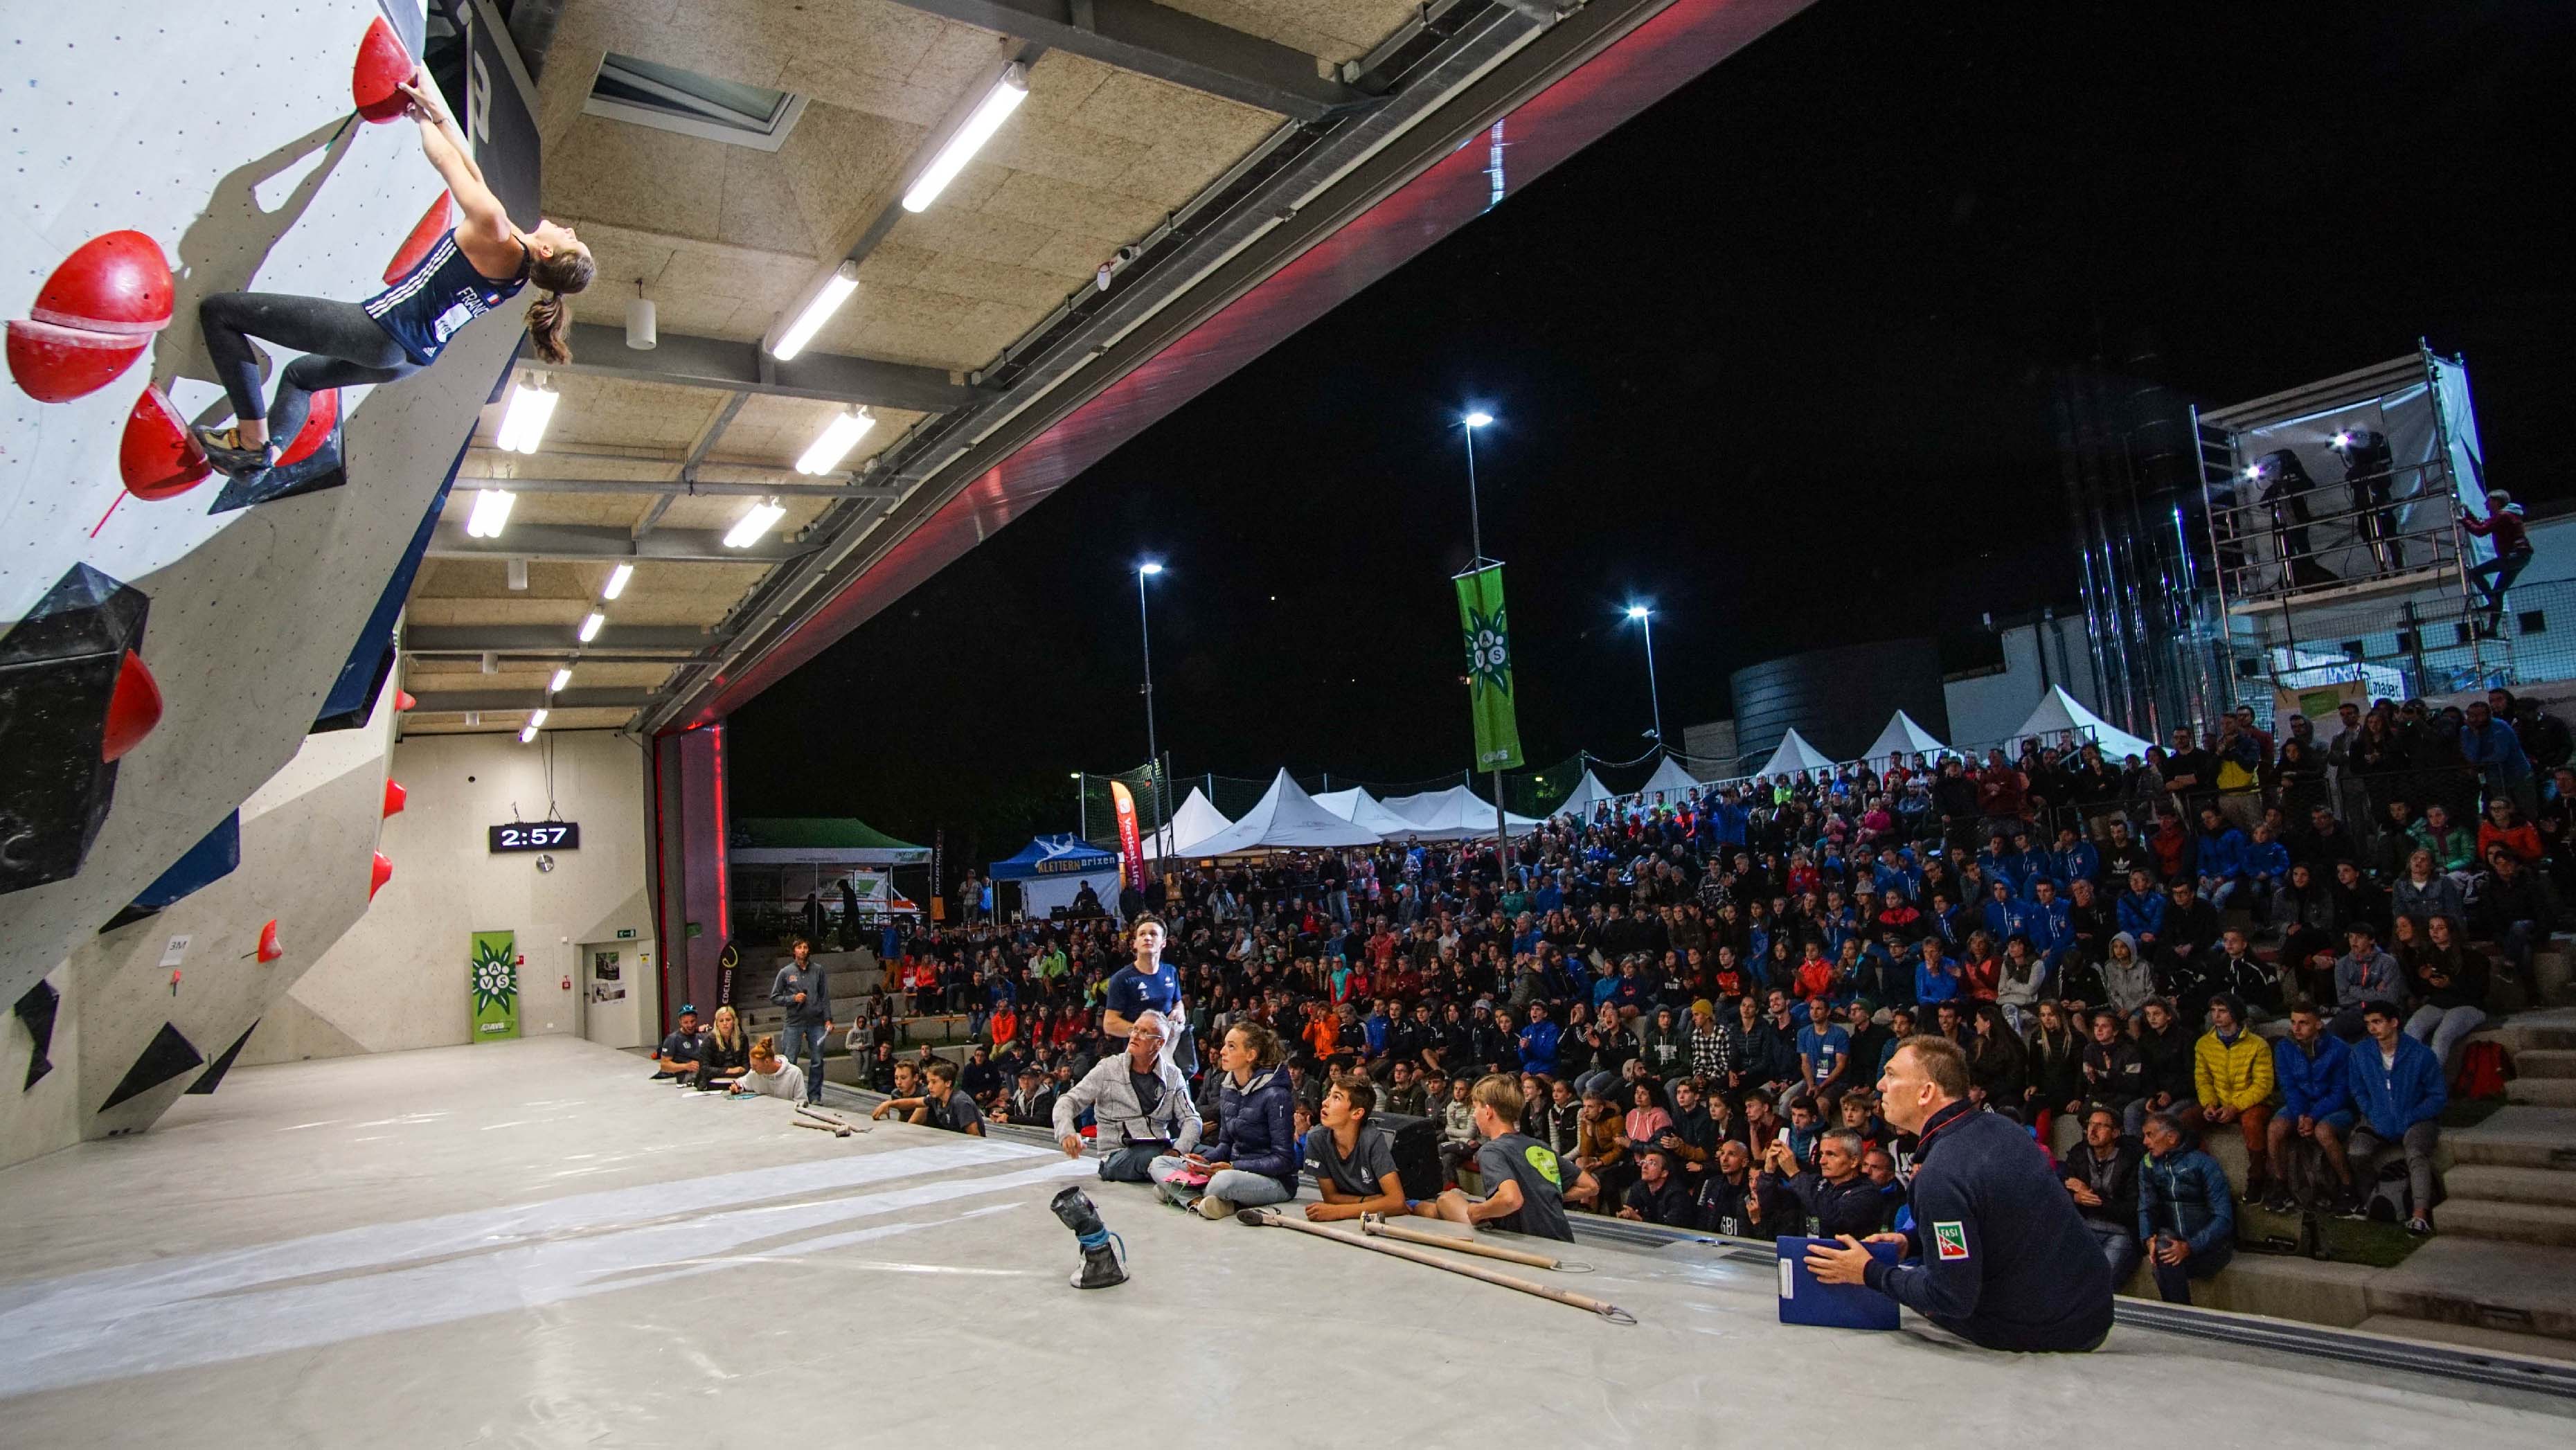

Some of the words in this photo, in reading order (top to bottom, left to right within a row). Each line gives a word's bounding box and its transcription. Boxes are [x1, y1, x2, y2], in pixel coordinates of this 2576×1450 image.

[501, 827, 567, 846] 2:57
[1124, 817, 1139, 886] Vertical-Life
[1039, 860, 1081, 873] KLETTERN
[490, 963, 499, 972] A
[499, 976, 507, 986] S
[722, 969, 732, 1004] EDELRID
[1940, 1228, 1959, 1237] FASI
